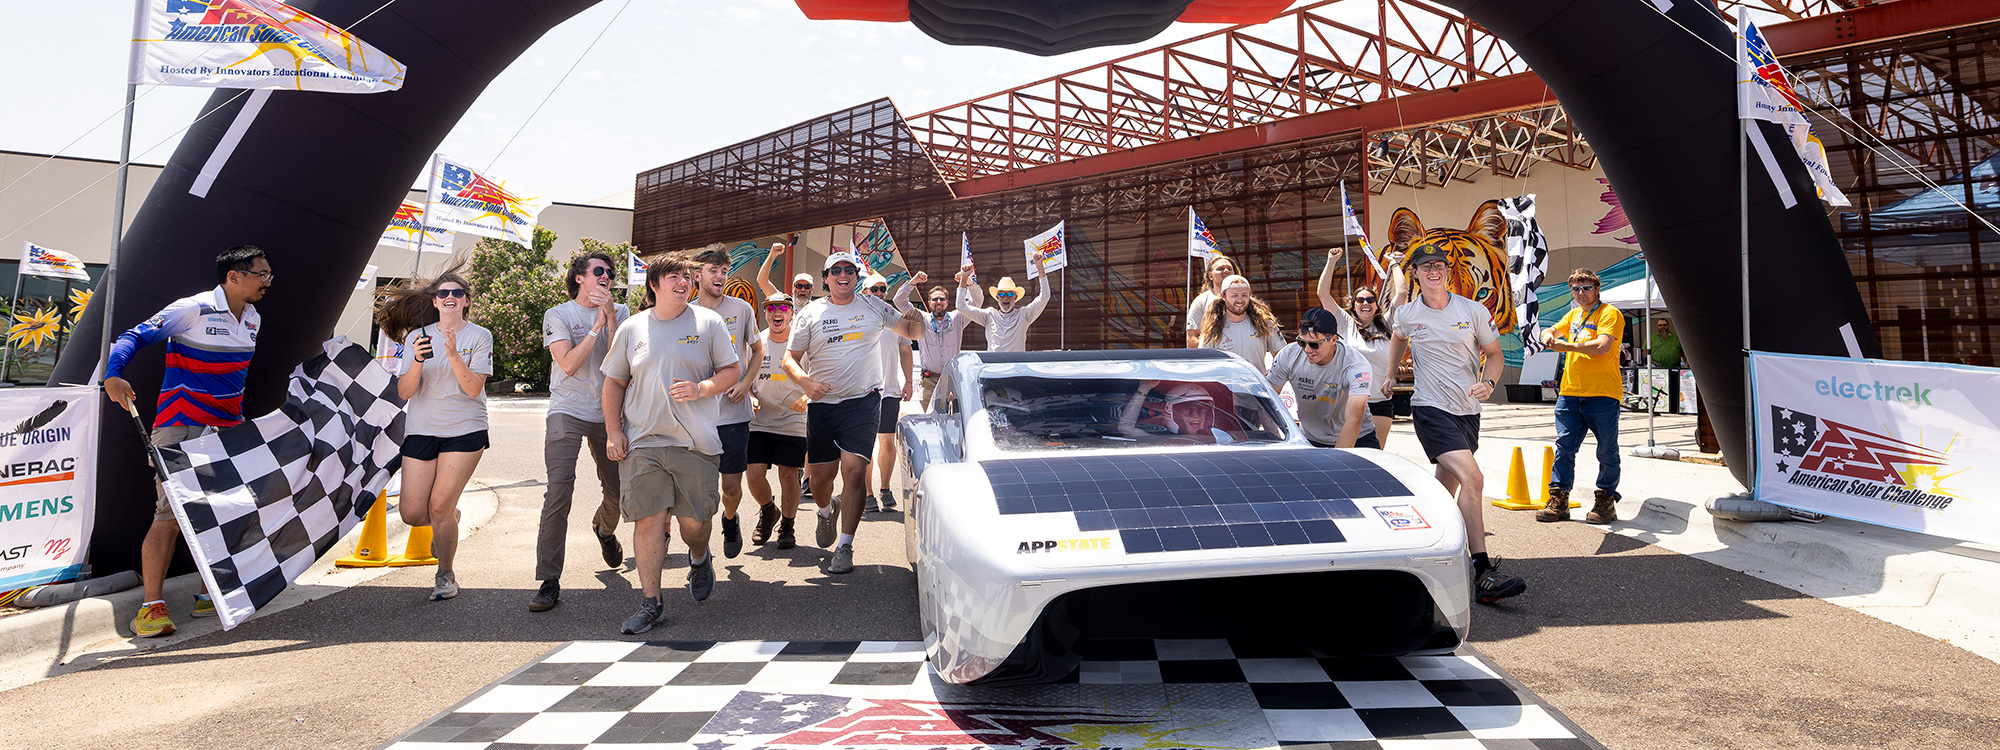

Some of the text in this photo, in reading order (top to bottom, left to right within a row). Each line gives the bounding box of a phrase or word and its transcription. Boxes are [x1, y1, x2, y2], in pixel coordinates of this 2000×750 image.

[164, 23, 251, 43] American
[160, 65, 197, 75] Hosted
[200, 66, 213, 77] By
[216, 66, 271, 77] Innovators
[273, 68, 330, 79] Educational
[440, 194, 483, 212] American
[482, 201, 504, 215] Solar
[1815, 376, 1933, 406] electrek
[22, 426, 71, 446] ORIGIN
[1788, 470, 1954, 511] American Solar Challenge
[1016, 537, 1112, 554] APPSTATE
